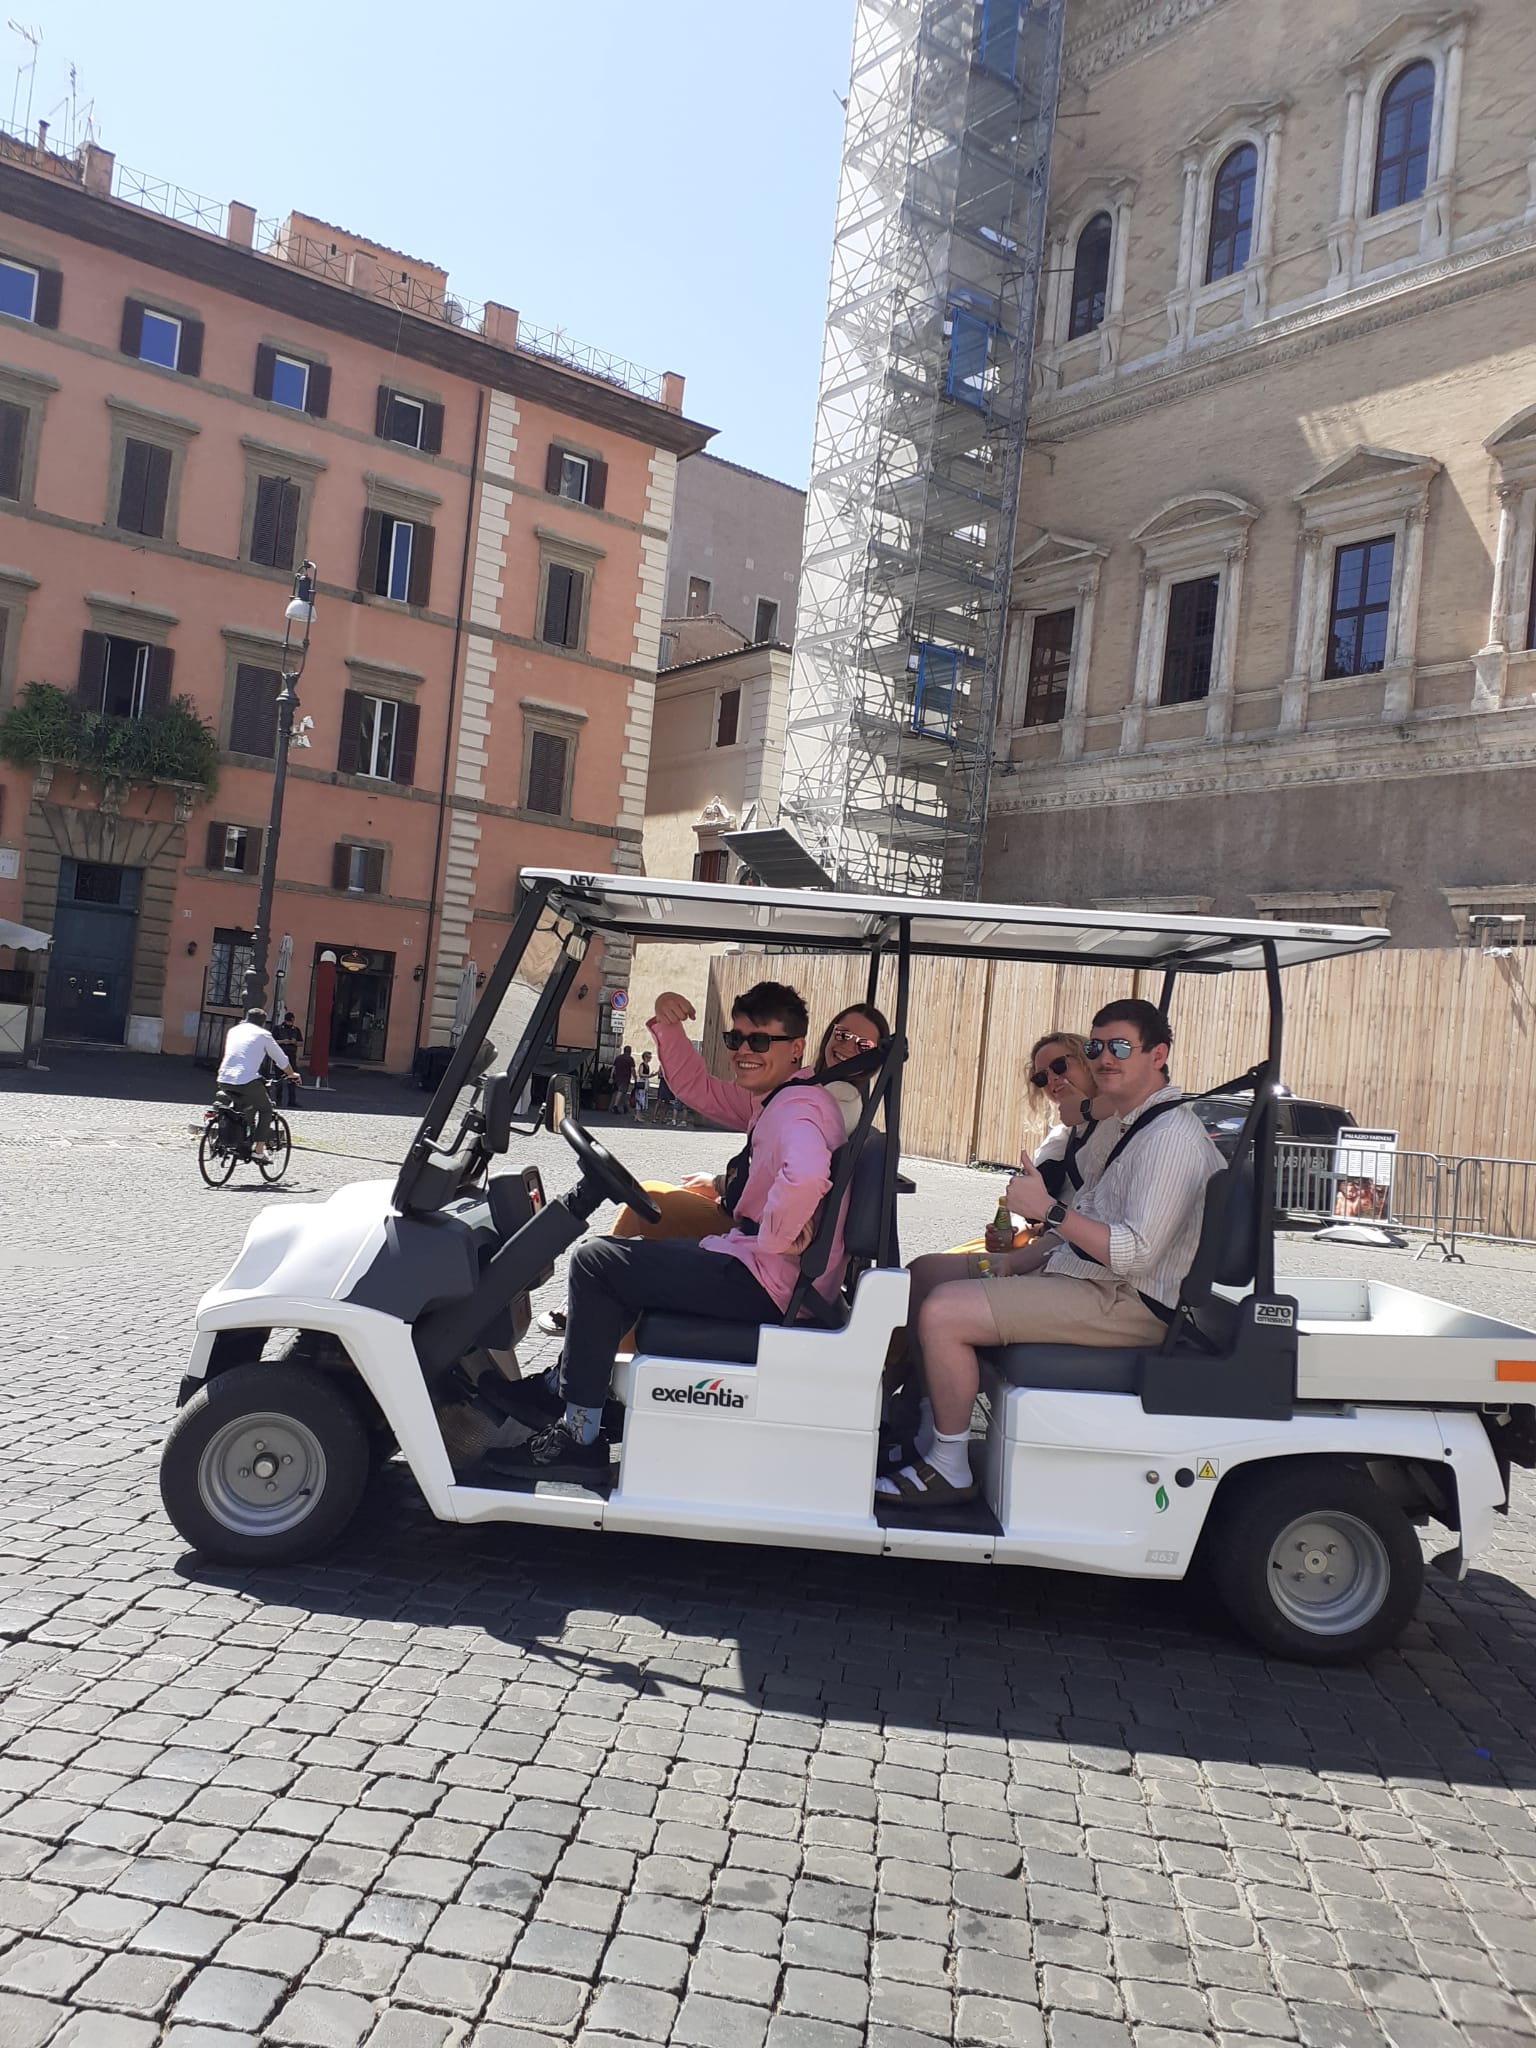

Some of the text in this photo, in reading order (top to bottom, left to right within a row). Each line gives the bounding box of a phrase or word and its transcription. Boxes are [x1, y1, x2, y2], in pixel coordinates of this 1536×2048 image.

[571, 875, 595, 886] NEV
[1257, 1305, 1291, 1318] zero
[651, 1385, 745, 1408] exelentia
